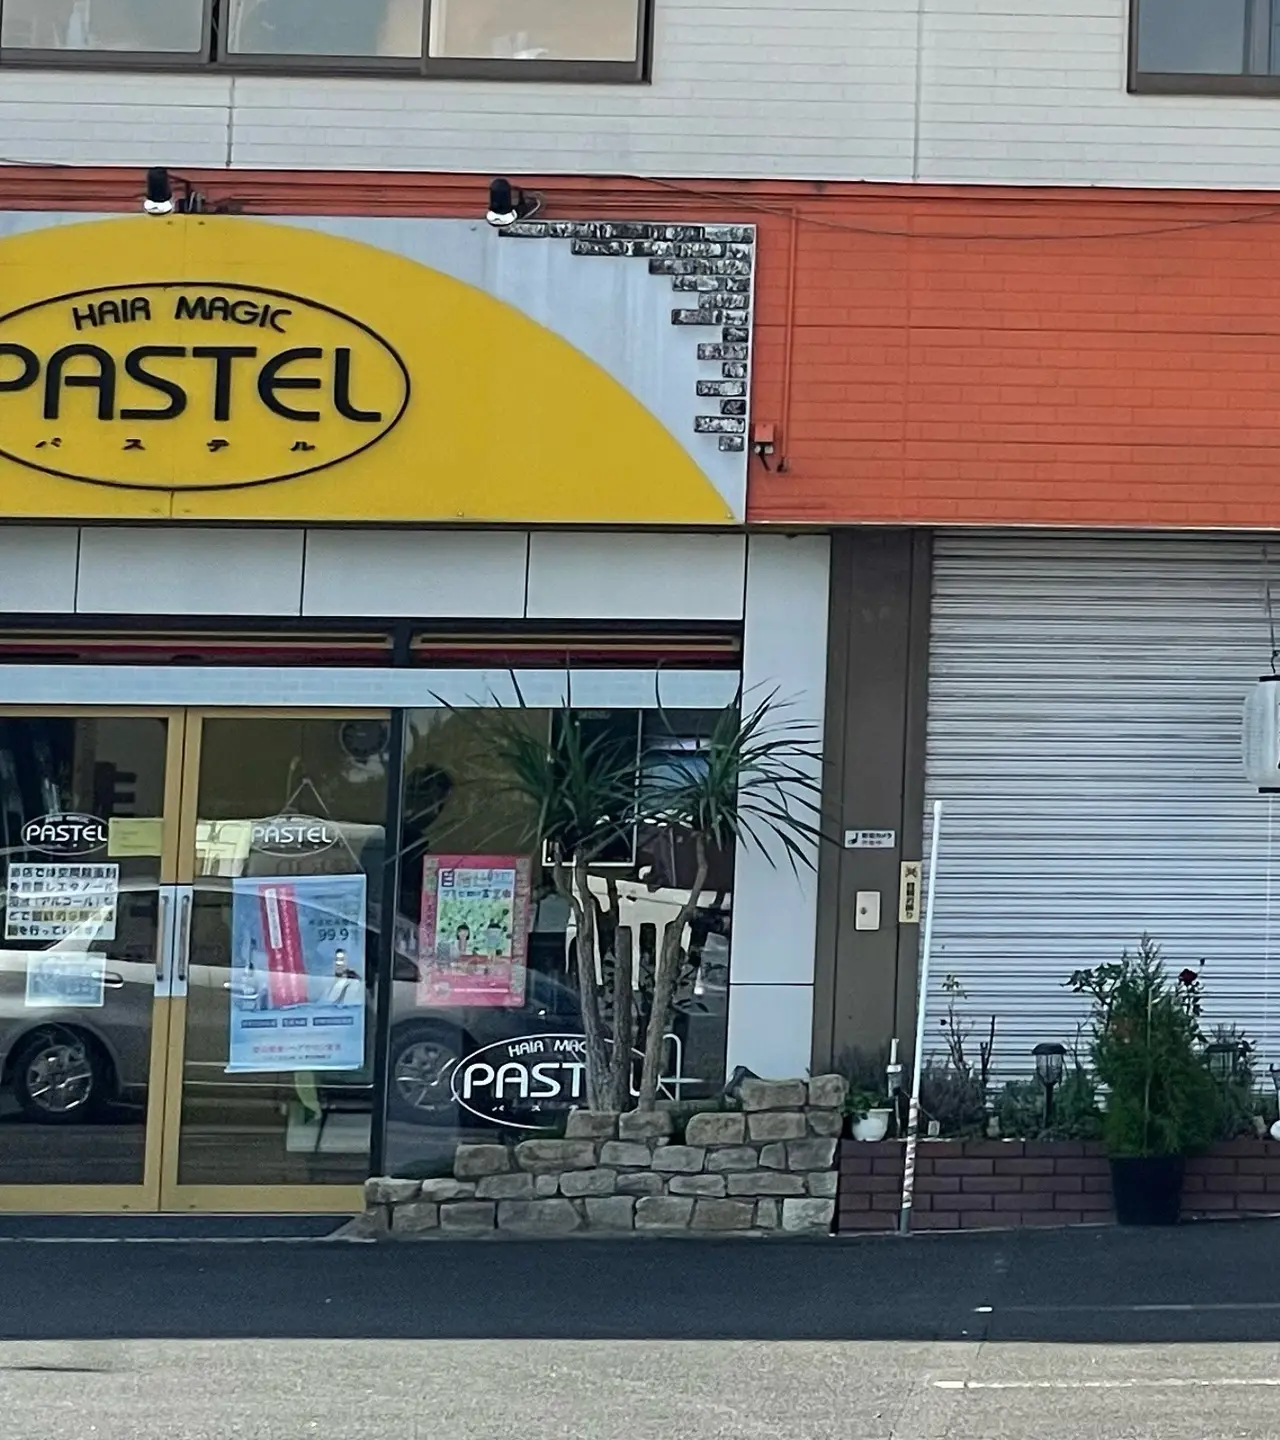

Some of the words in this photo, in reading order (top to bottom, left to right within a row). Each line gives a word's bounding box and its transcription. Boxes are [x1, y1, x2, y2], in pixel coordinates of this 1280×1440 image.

[73, 296, 151, 331] HAIR
[175, 296, 292, 333] MAGIC
[26, 825, 108, 841] PASTEL
[251, 826, 332, 843] PASTEL
[508, 1040, 544, 1058] HAIR
